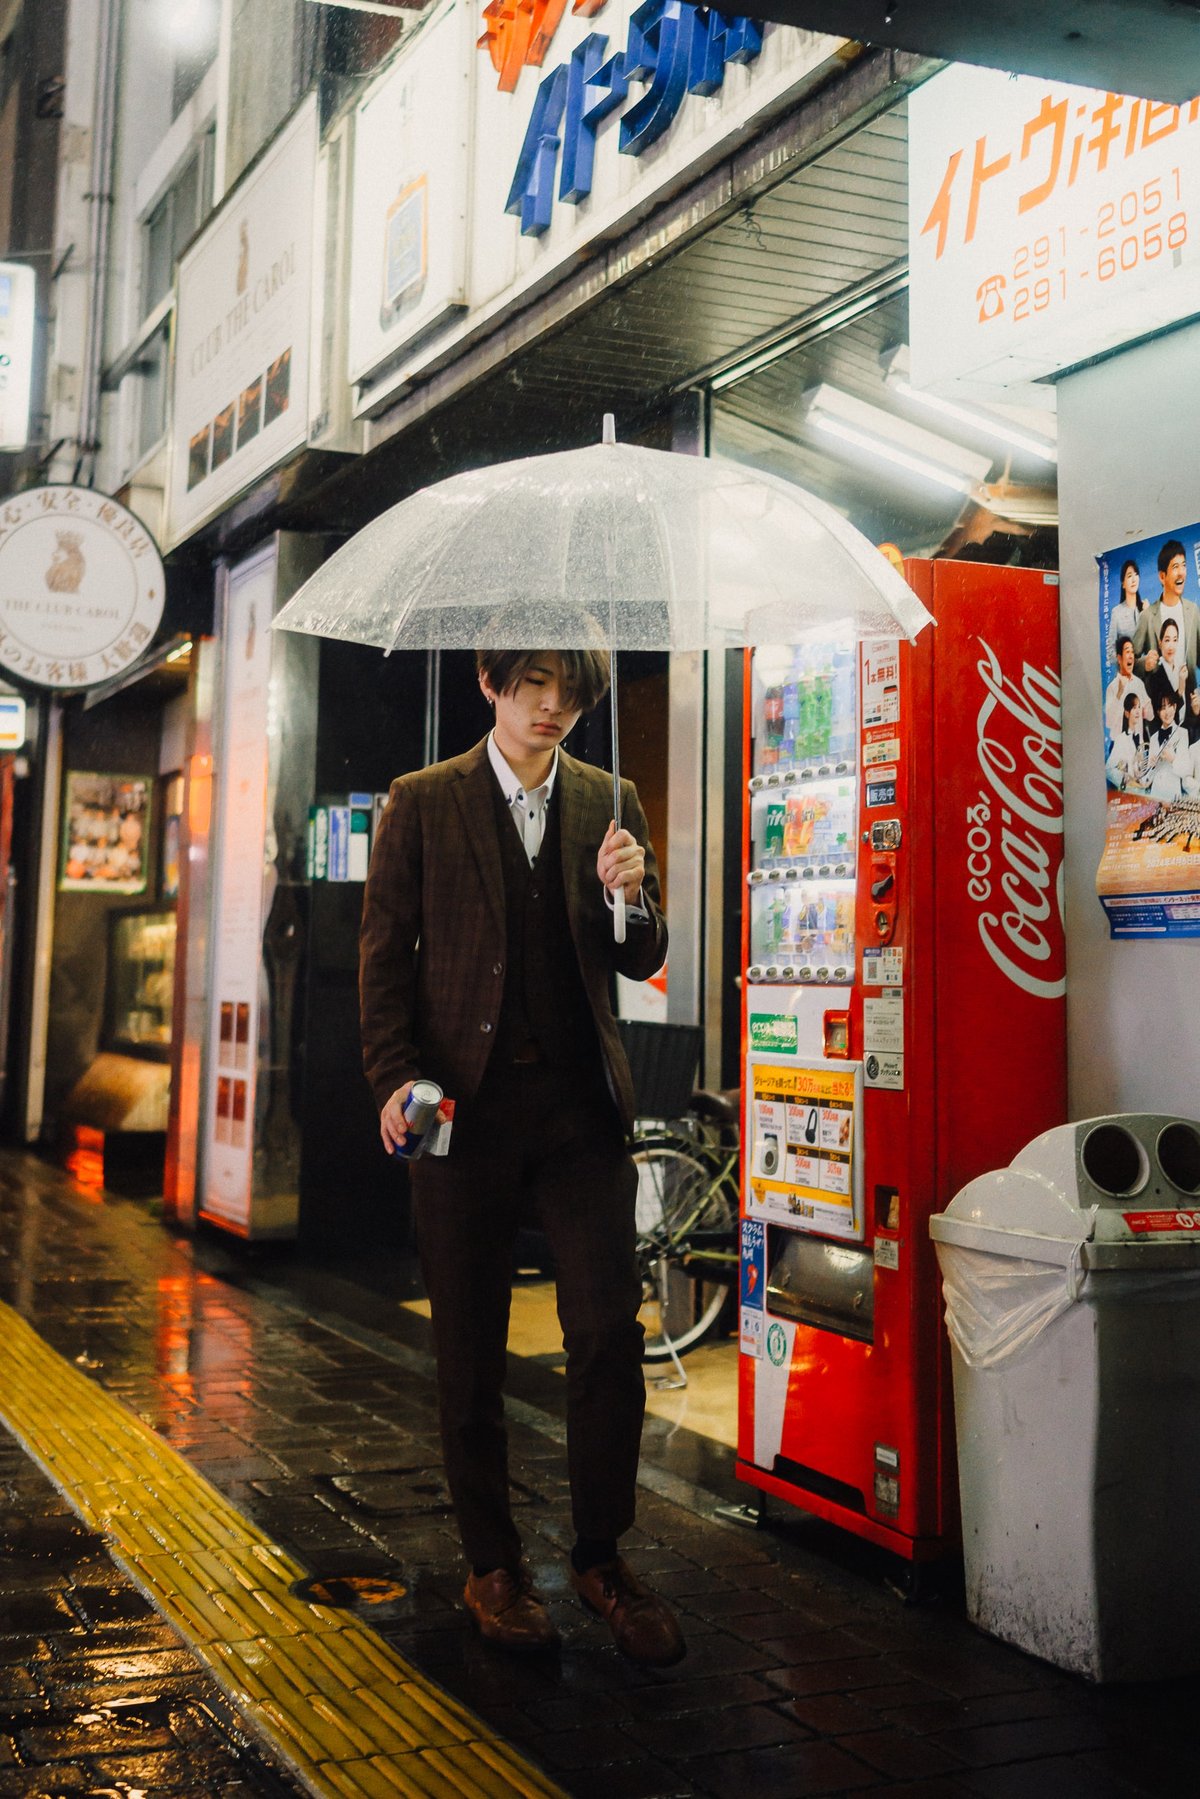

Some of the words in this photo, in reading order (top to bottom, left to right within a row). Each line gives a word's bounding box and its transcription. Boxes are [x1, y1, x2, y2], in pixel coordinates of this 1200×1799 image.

[1013, 167, 1181, 280] 291-2051
[1013, 212, 1187, 321] 291-6058
[226, 293, 250, 344] THE
[253, 241, 296, 314] CAROL
[6, 600, 30, 612] THE
[35, 602, 74, 616] CLUB
[76, 605, 121, 620] CAROL
[870, 786, 895, 802] 販売中
[977, 635, 1067, 999] Coca-Cola
